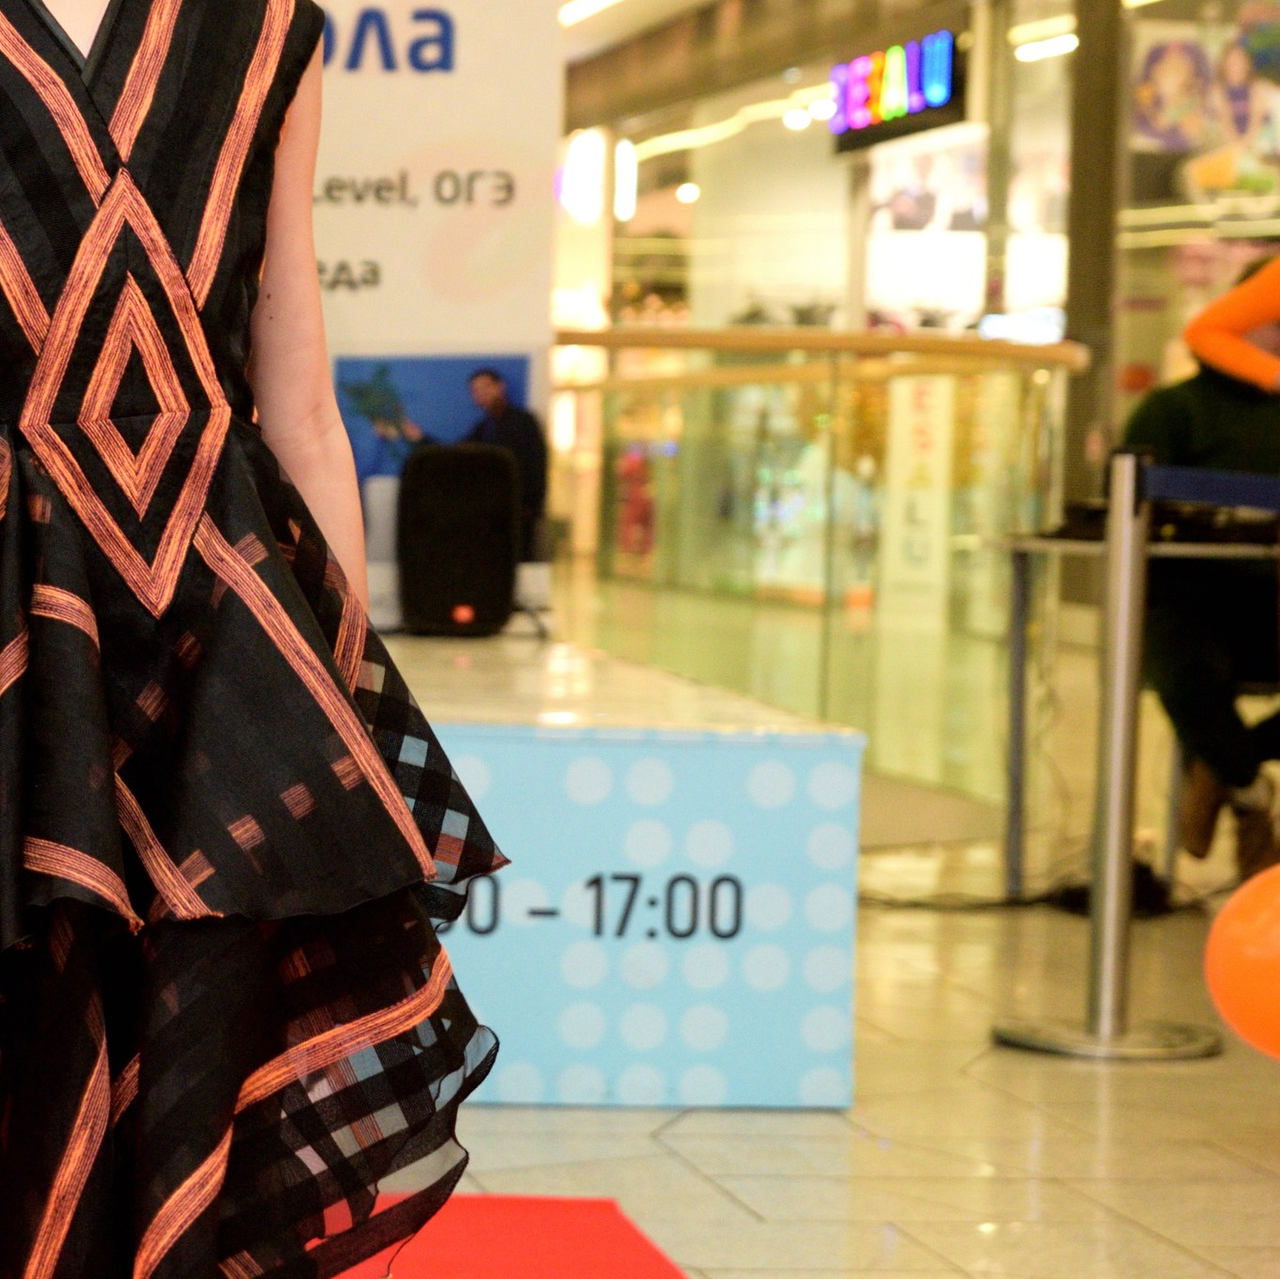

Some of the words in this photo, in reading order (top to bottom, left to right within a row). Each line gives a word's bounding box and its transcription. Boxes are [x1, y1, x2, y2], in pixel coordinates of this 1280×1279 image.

[314, 169, 418, 210] evel,
[432, 169, 517, 207] ОГЭ
[583, 871, 745, 942] 17:00
